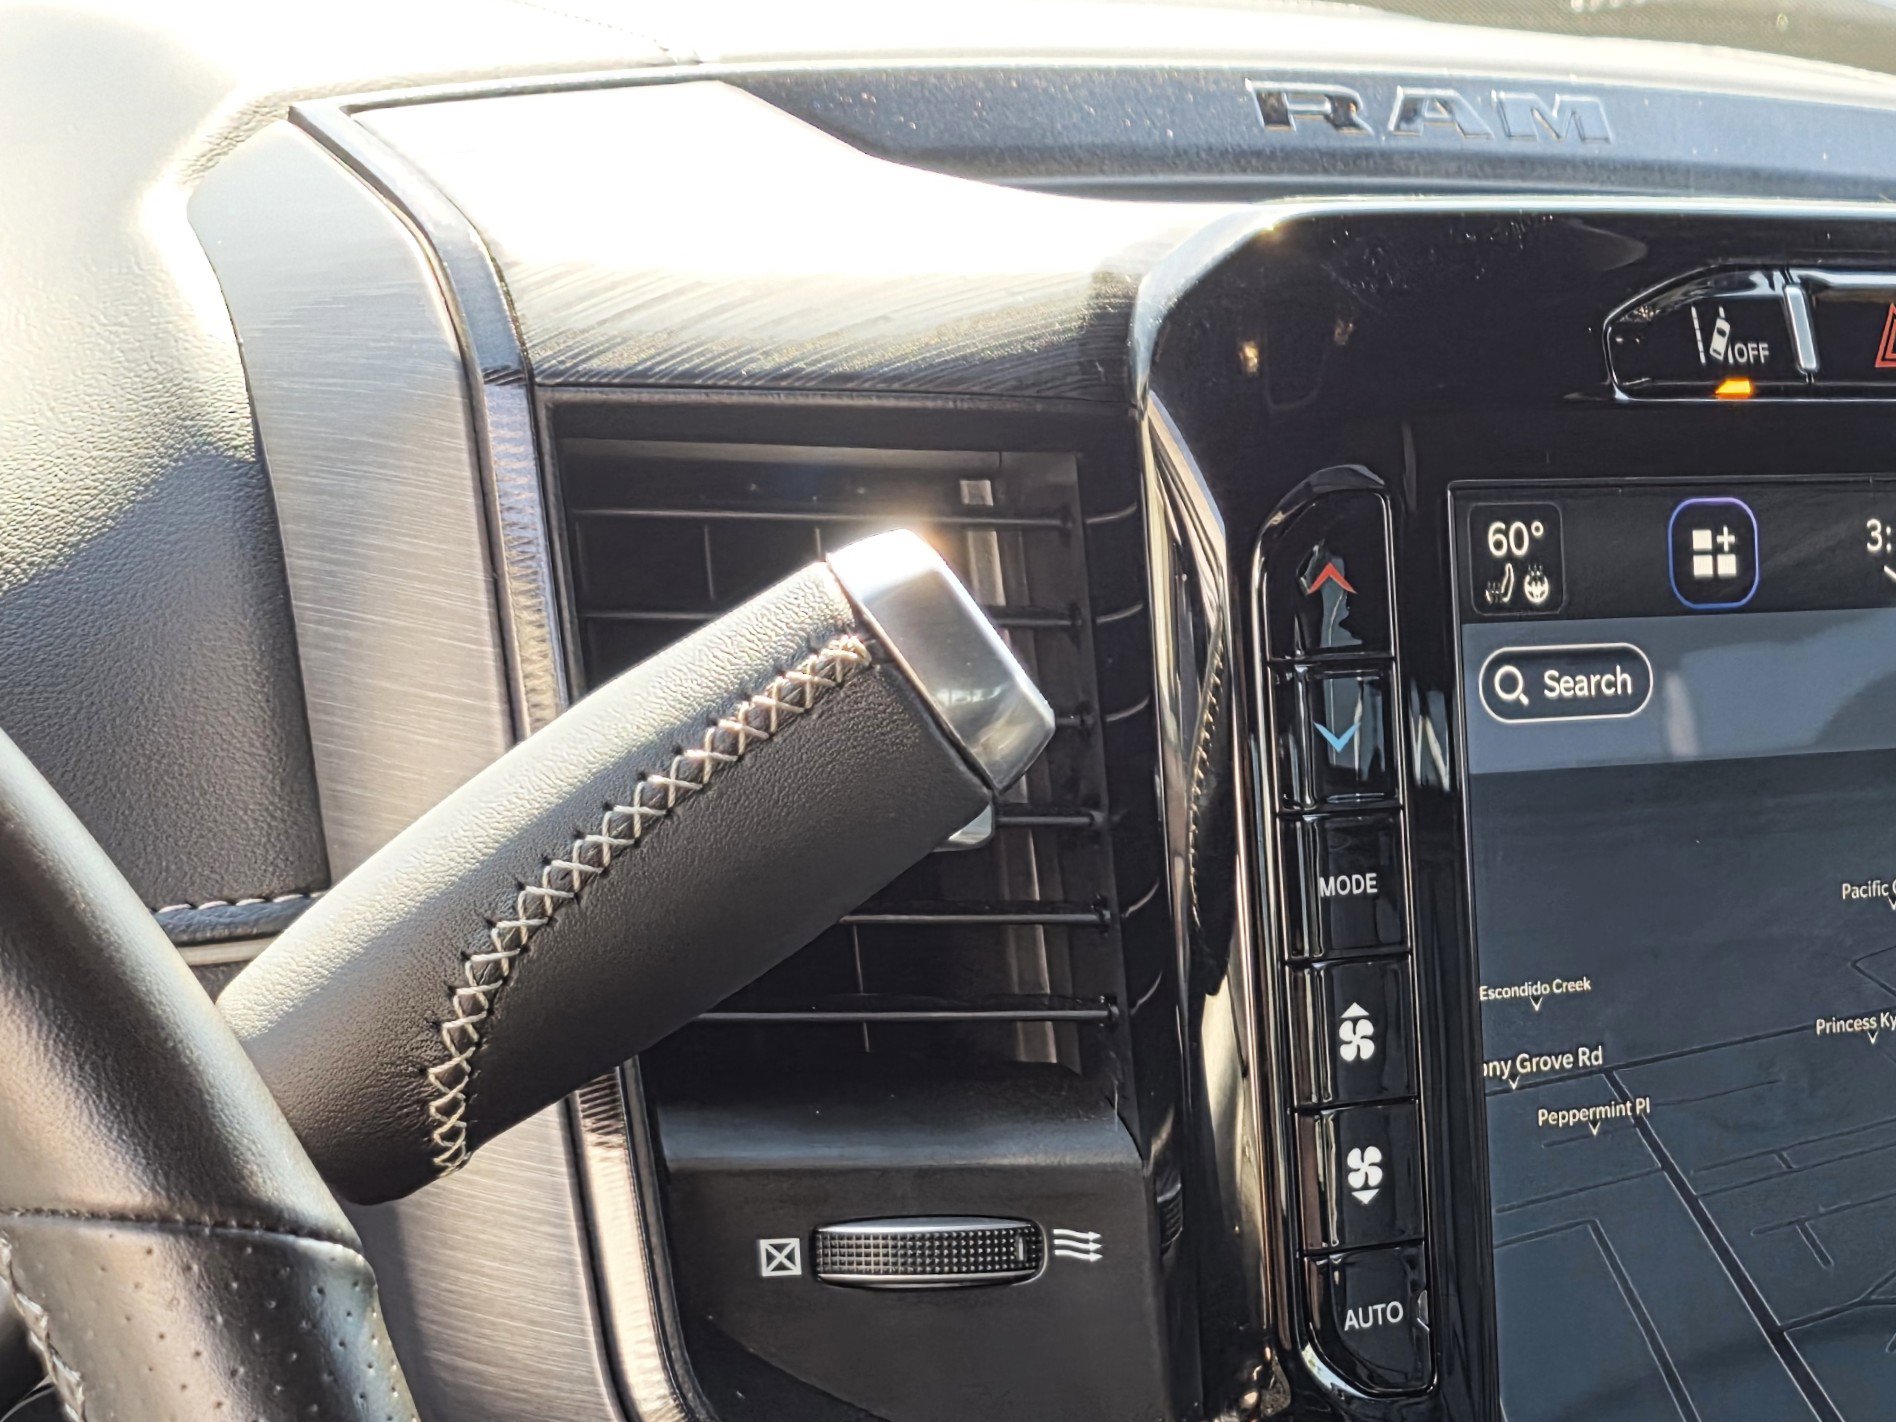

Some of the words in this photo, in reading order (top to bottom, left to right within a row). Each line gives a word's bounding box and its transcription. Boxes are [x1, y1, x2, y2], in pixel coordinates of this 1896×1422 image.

[1245, 78, 1615, 144] RAM
[1735, 343, 1769, 364] OFF
[1487, 520, 1545, 557] 60°
[1543, 666, 1632, 699] Search
[1319, 872, 1378, 898] MODE
[1842, 880, 1889, 900] Pacific
[1480, 980, 1550, 1000] Escondido
[1553, 975, 1591, 995] Creek
[1815, 1016, 1877, 1035] Princess
[1516, 1053, 1574, 1074] Grove
[1578, 1045, 1603, 1067] Rd
[1538, 1100, 1632, 1127] Peppermint
[1636, 1097, 1650, 1113] Pl
[1344, 1300, 1404, 1331] AUTO
